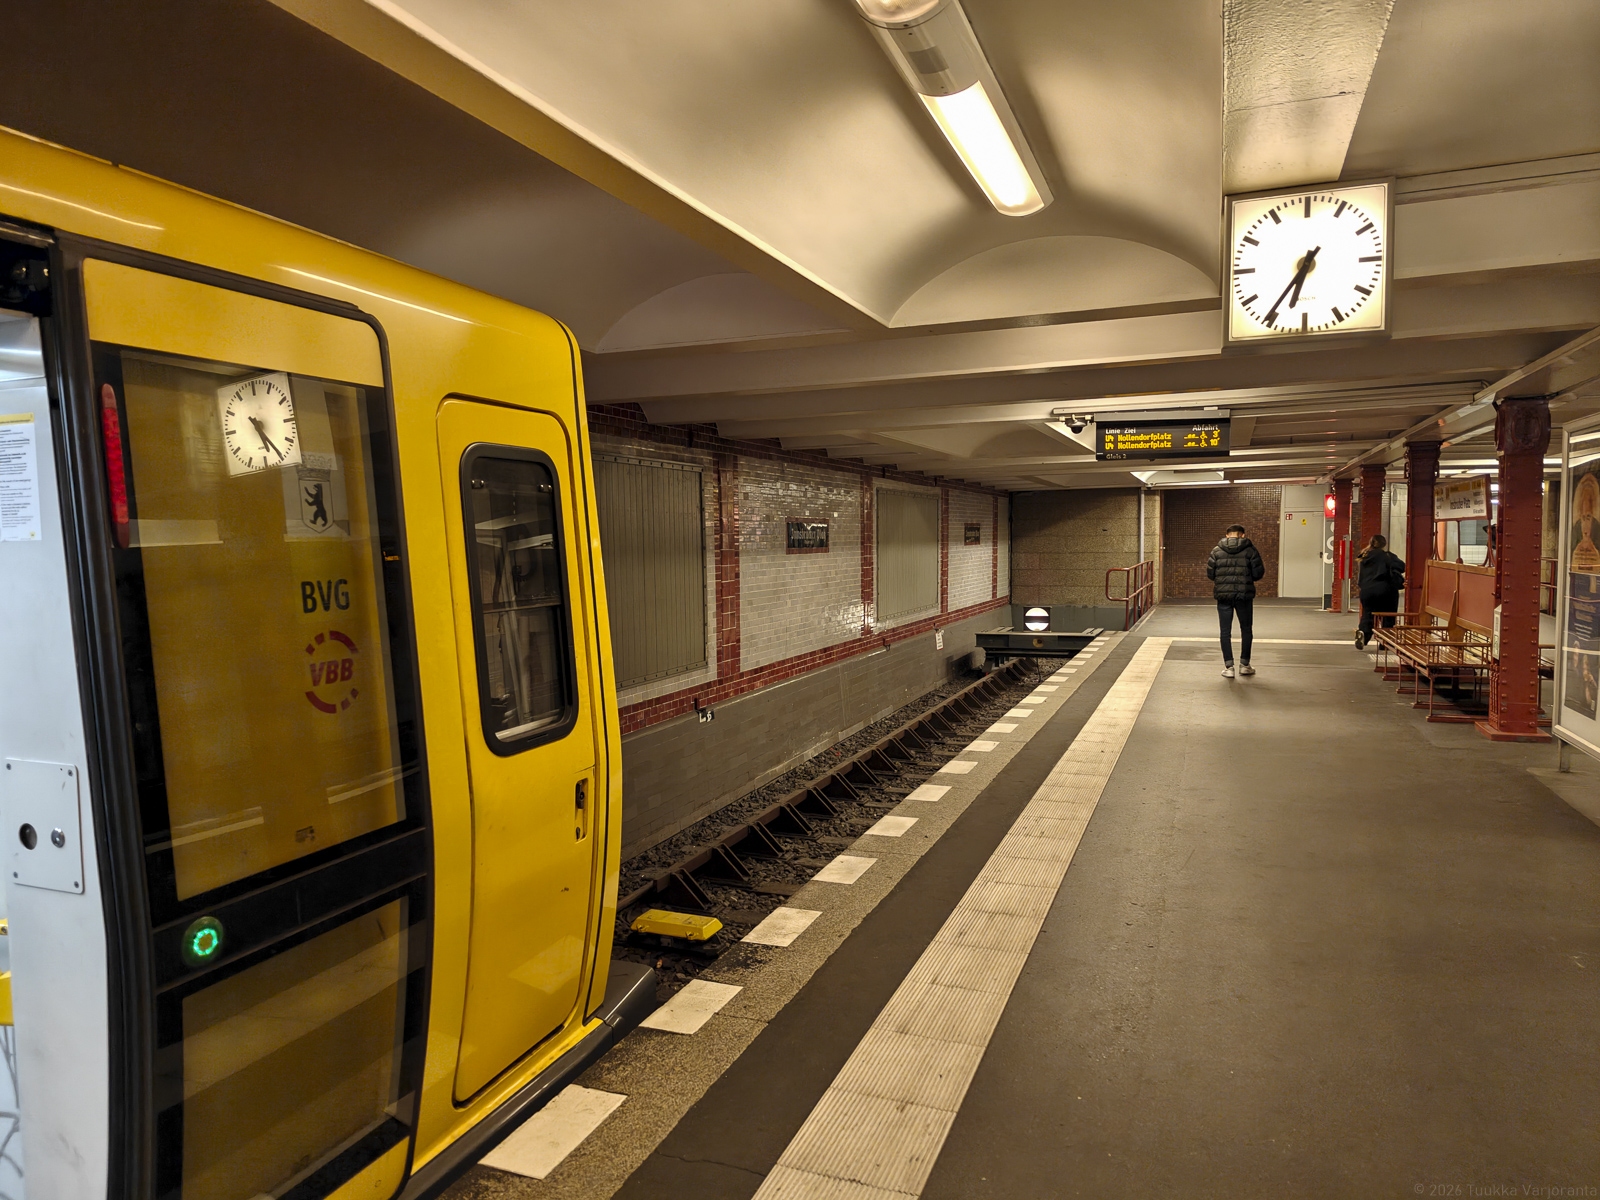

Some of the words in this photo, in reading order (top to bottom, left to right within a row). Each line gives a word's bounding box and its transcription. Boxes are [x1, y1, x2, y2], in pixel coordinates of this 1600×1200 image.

[1105, 442, 1114, 450] U4
[1117, 441, 1172, 450] Nollendorfplatz
[1117, 433, 1172, 442] Nollendorfplatz
[301, 578, 350, 613] BVG
[309, 657, 354, 687] VBB
